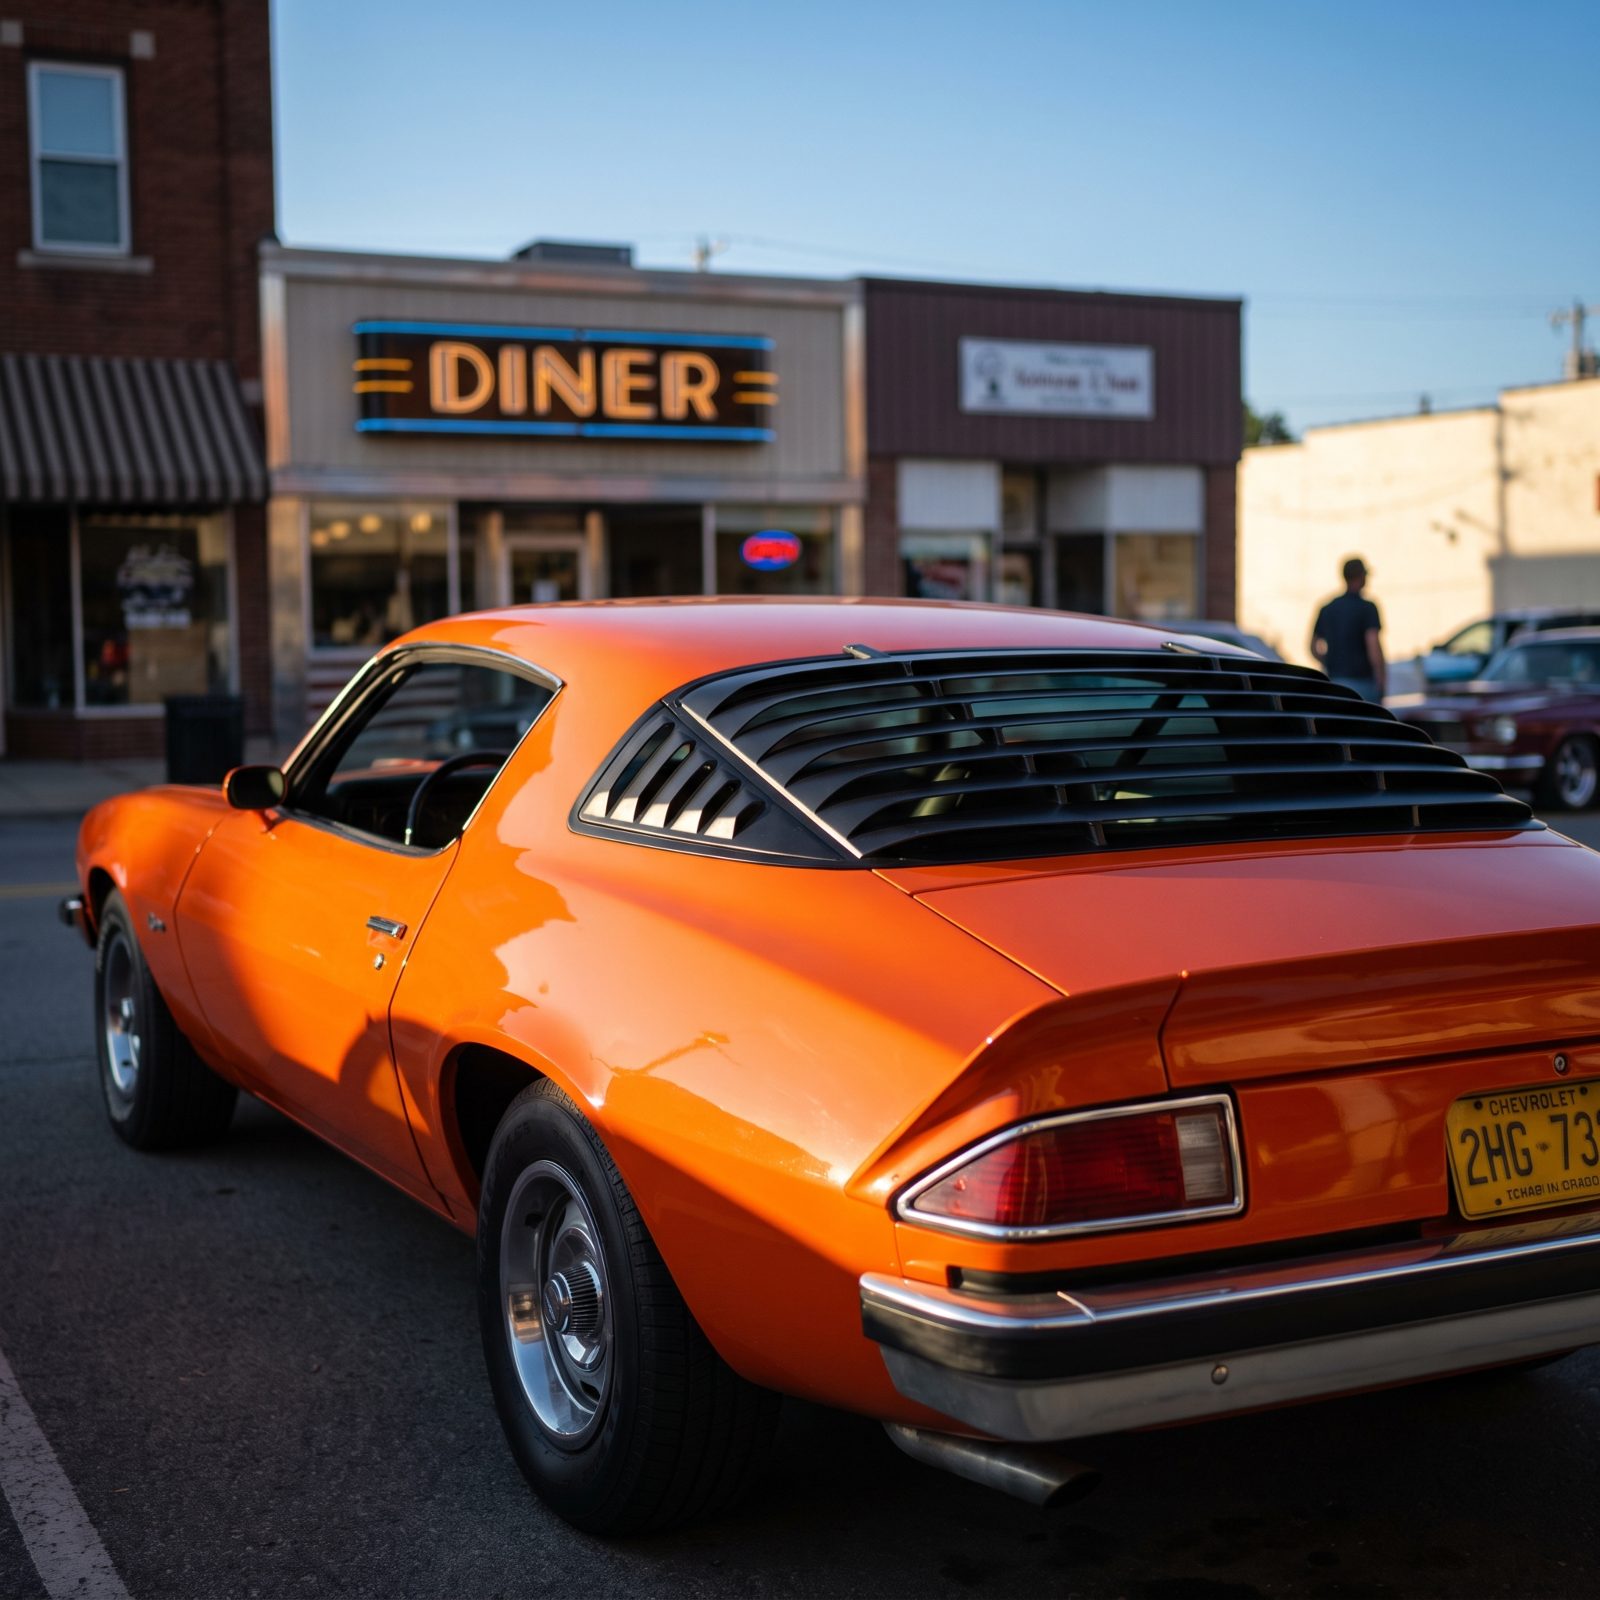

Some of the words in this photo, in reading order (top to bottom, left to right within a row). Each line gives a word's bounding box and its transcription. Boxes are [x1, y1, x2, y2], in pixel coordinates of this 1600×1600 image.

[429, 340, 720, 420] DINER
[1488, 1089, 1576, 1117] CHEVROLET
[1549, 1109, 1600, 1171] 73
